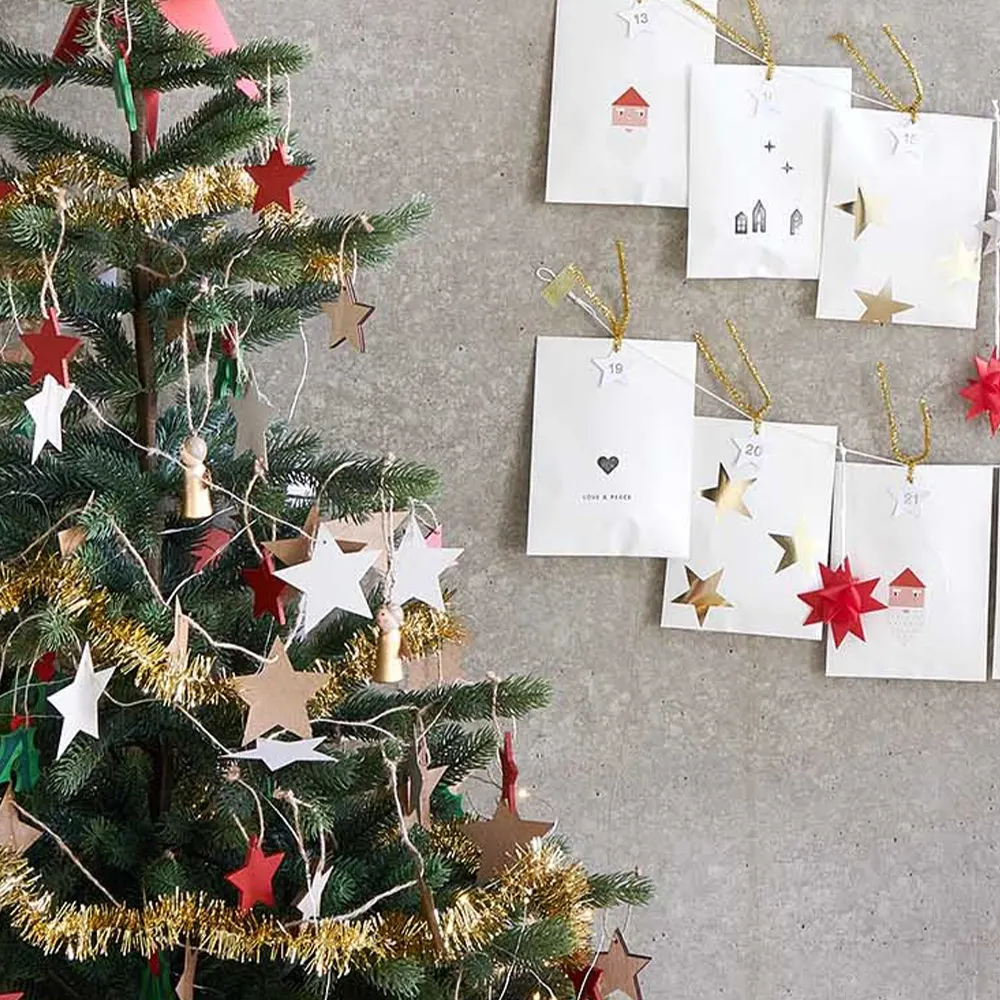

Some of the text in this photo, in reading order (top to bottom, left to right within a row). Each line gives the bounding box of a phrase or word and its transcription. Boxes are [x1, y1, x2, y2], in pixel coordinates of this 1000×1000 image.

[633, 12, 649, 25] 13
[608, 362, 624, 375] 19
[744, 443, 763, 457] 20
[903, 492, 919, 505] 21
